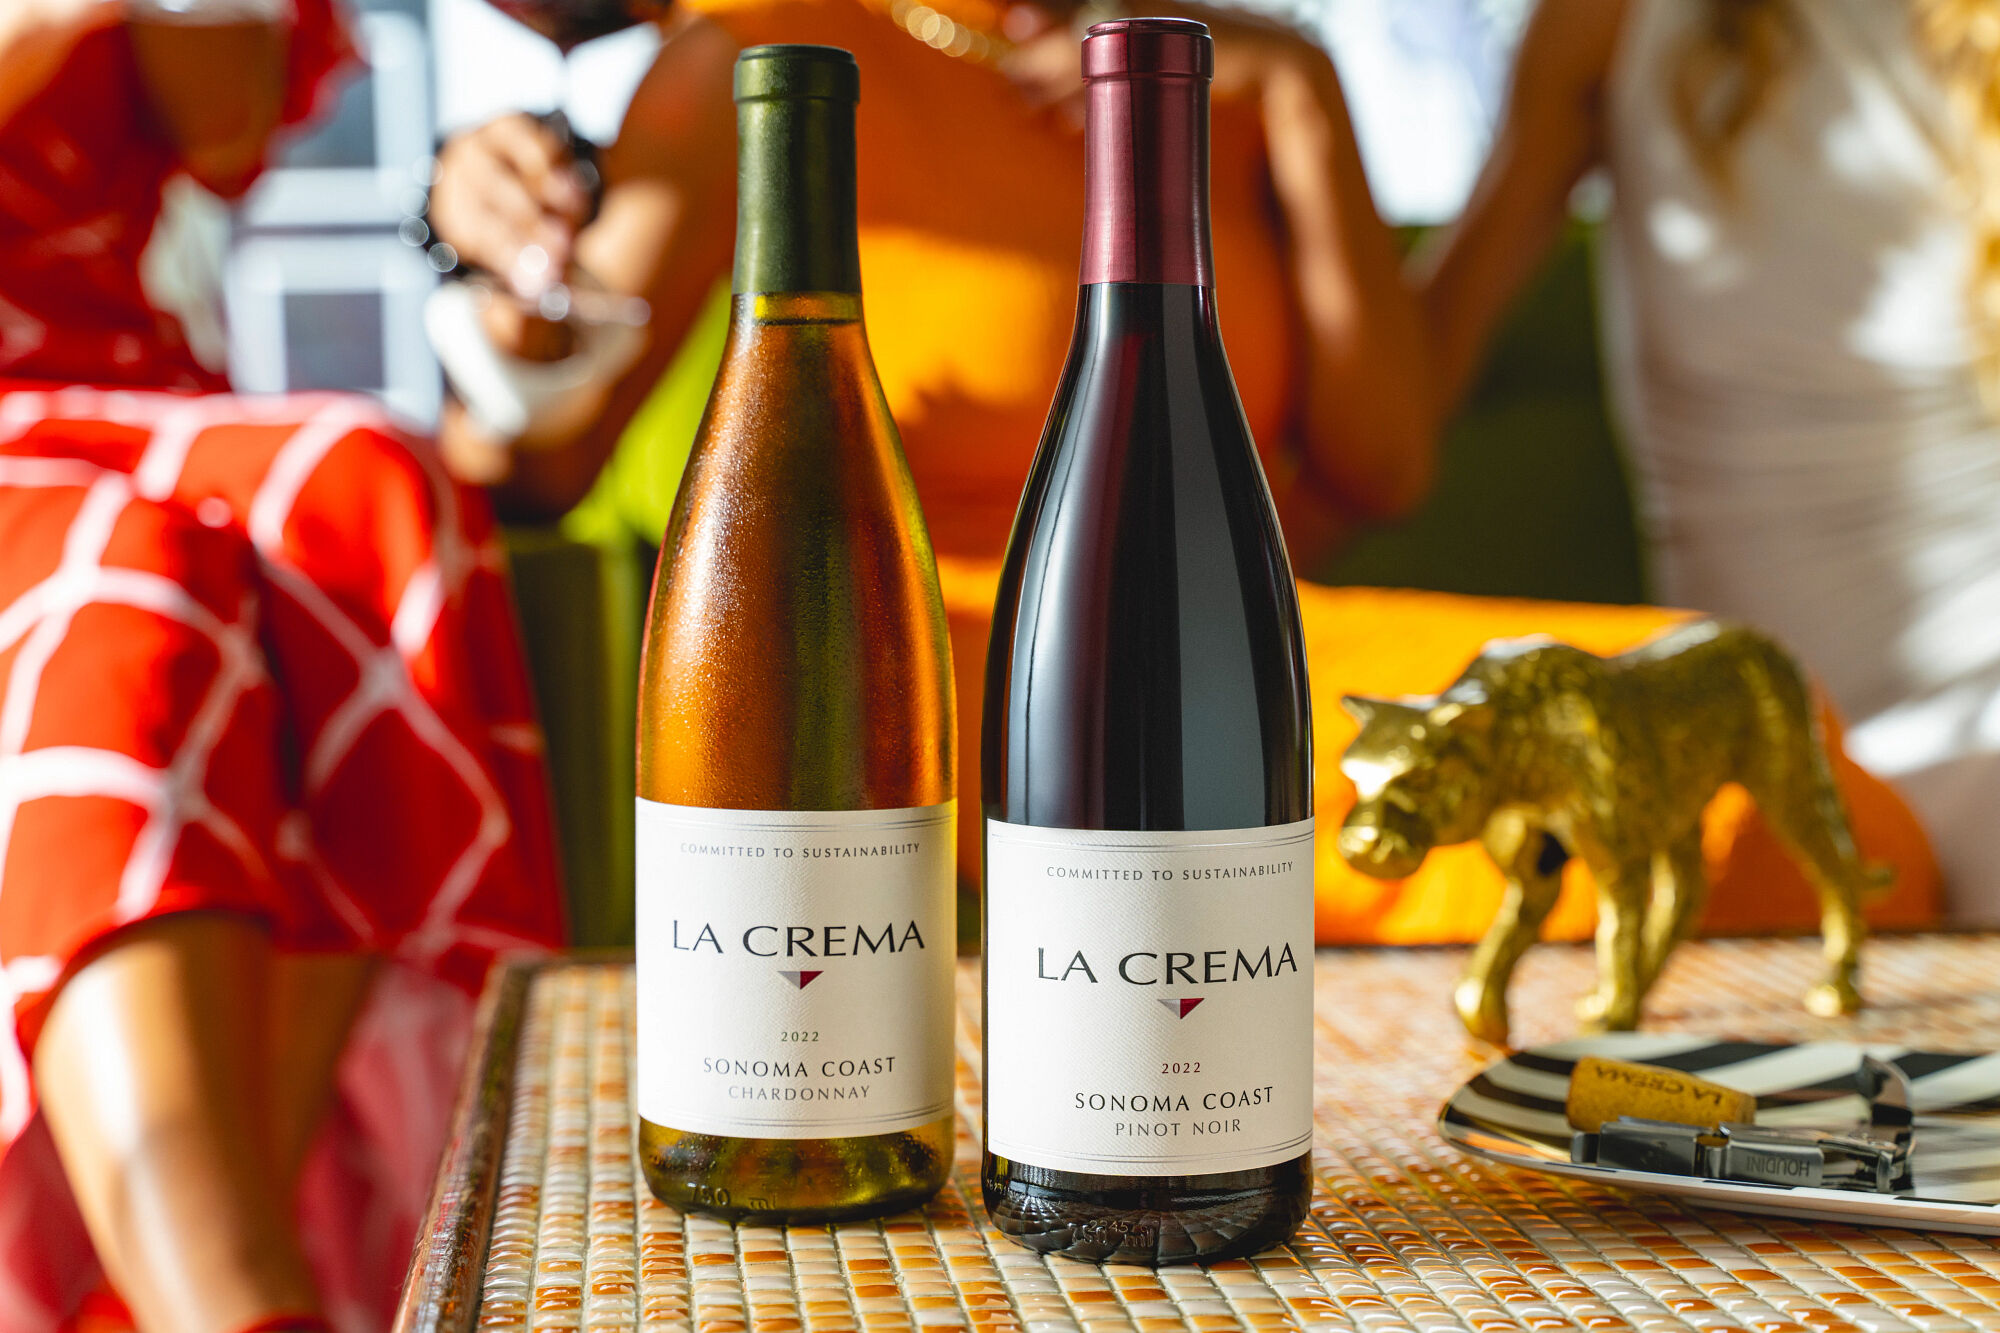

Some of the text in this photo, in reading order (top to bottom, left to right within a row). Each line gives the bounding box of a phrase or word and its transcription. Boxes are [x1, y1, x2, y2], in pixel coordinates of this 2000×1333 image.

[680, 842, 921, 859] COMMITTED TO SUSTAINABILITY
[1046, 861, 1294, 881] COMMITTED TO SUSTAINABILITY
[673, 919, 926, 958] LA CREMA
[1038, 942, 1298, 986] LA CREMA
[780, 1031, 820, 1043] 2022
[703, 1056, 896, 1078] SONOMA COAST
[1161, 1062, 1201, 1075] 2022
[728, 1085, 871, 1102] CHARDONNAY
[1595, 1066, 1722, 1106] LA CREMA
[1074, 1086, 1274, 1112] SONOMA COAST
[1115, 1118, 1241, 1137] PINOT NOIR
[1746, 1156, 1810, 1177] HOUDINI
